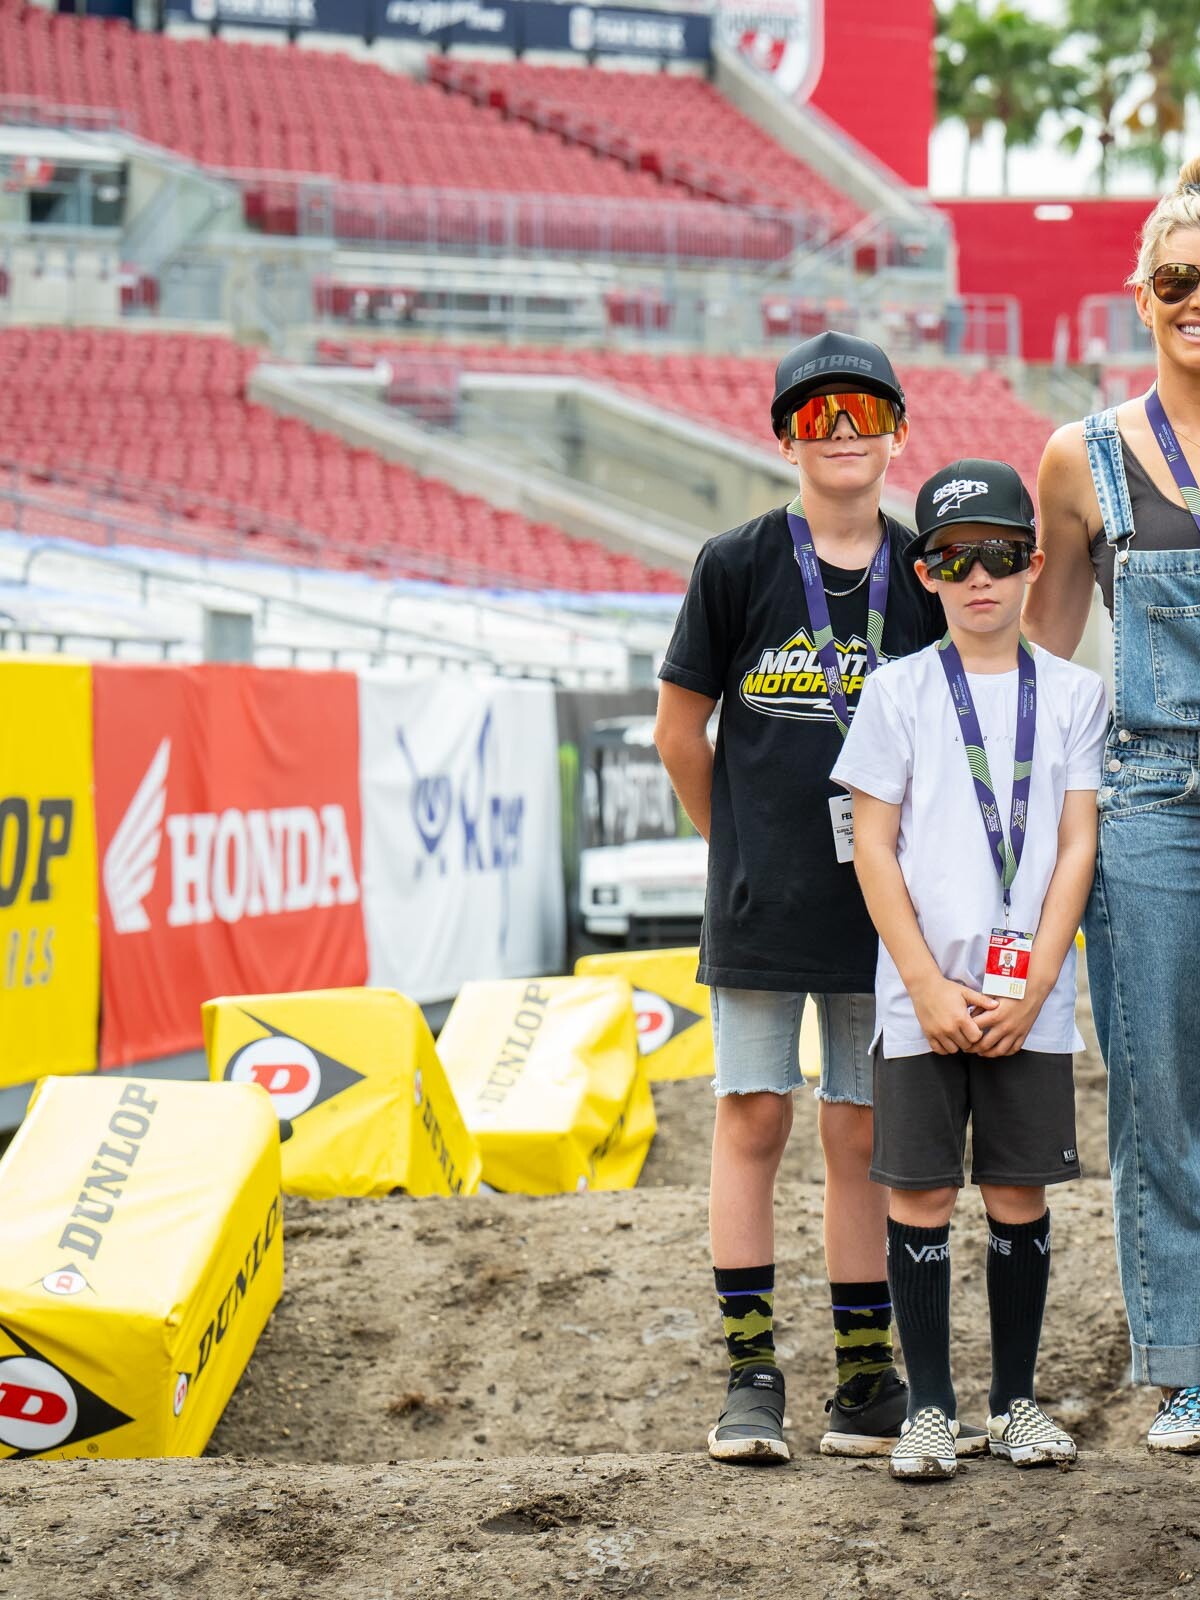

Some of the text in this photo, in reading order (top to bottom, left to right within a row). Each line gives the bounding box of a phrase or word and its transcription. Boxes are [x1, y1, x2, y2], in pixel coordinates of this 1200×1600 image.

[932, 479, 989, 505] astars
[166, 803, 360, 927] HONDA
[58, 1083, 158, 1260] DUNLOP
